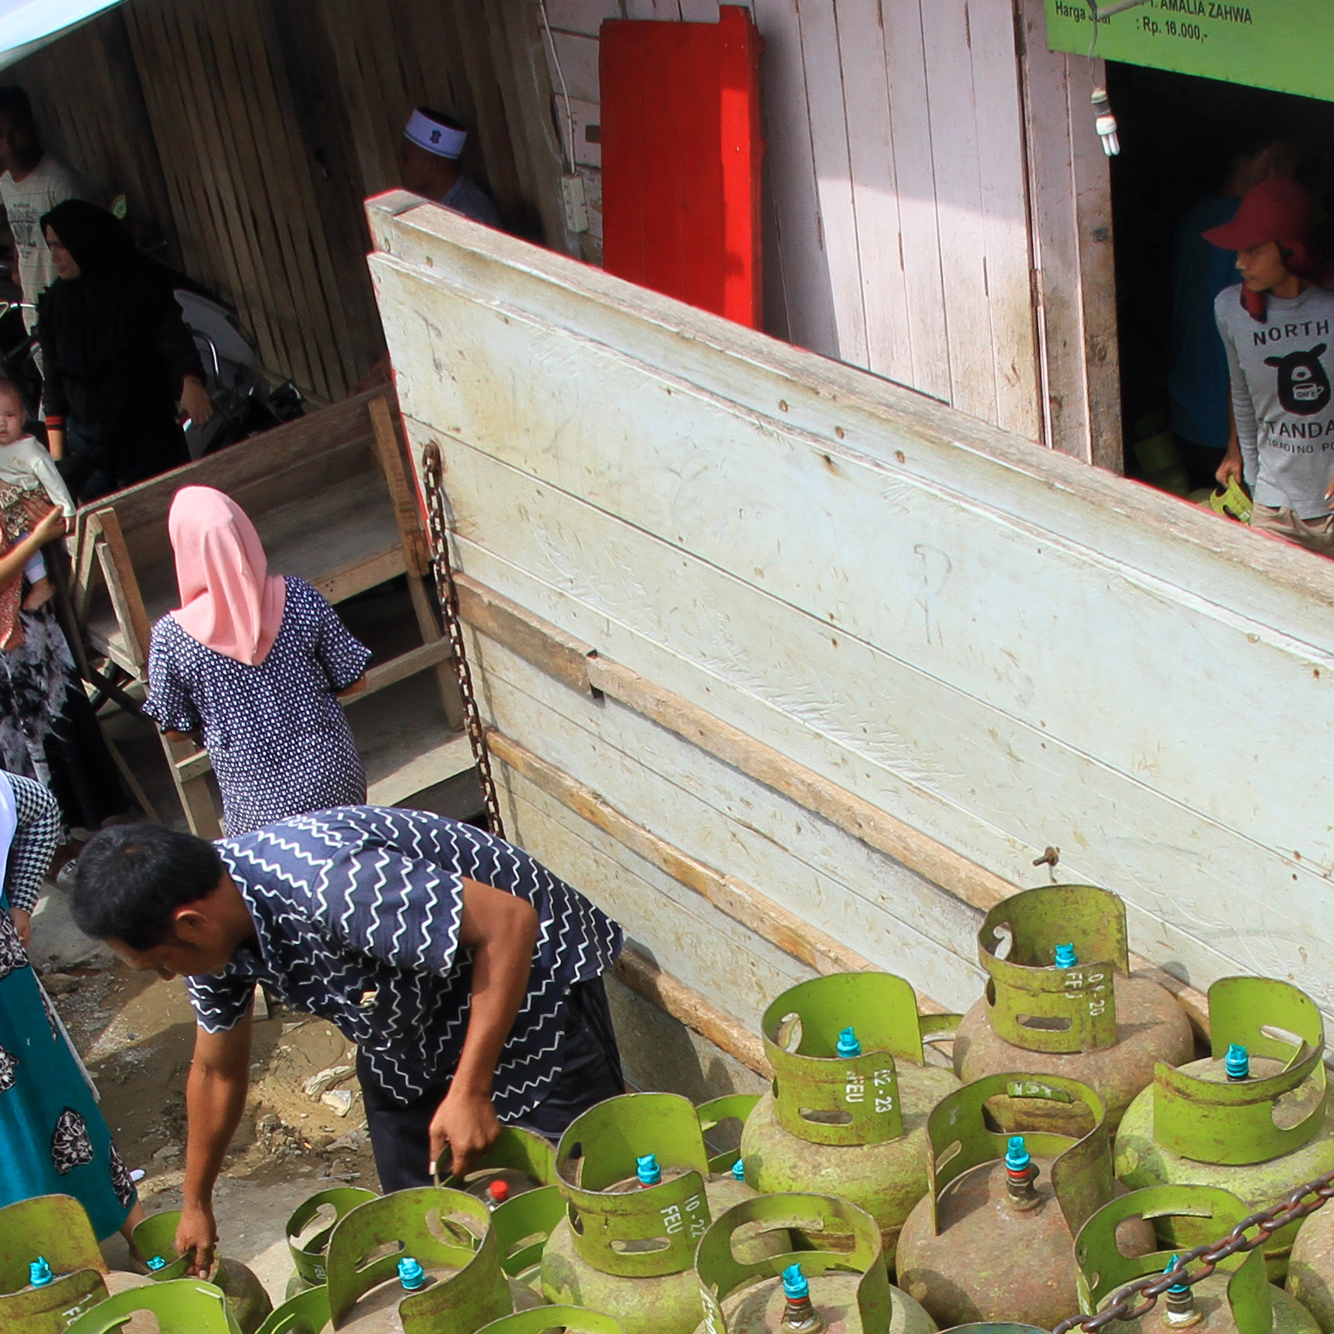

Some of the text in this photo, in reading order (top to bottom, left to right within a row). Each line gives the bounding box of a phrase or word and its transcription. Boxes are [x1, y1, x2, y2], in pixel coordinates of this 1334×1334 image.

[1056, 1, 1086, 22] Harga
[1143, 16, 1162, 36] Rp.
[1207, 5, 1253, 25] ZAHWA
[1253, 319, 1330, 346] NORTH
[660, 1204, 684, 1235] FEU
[684, 1193, 706, 1238] 10-22
